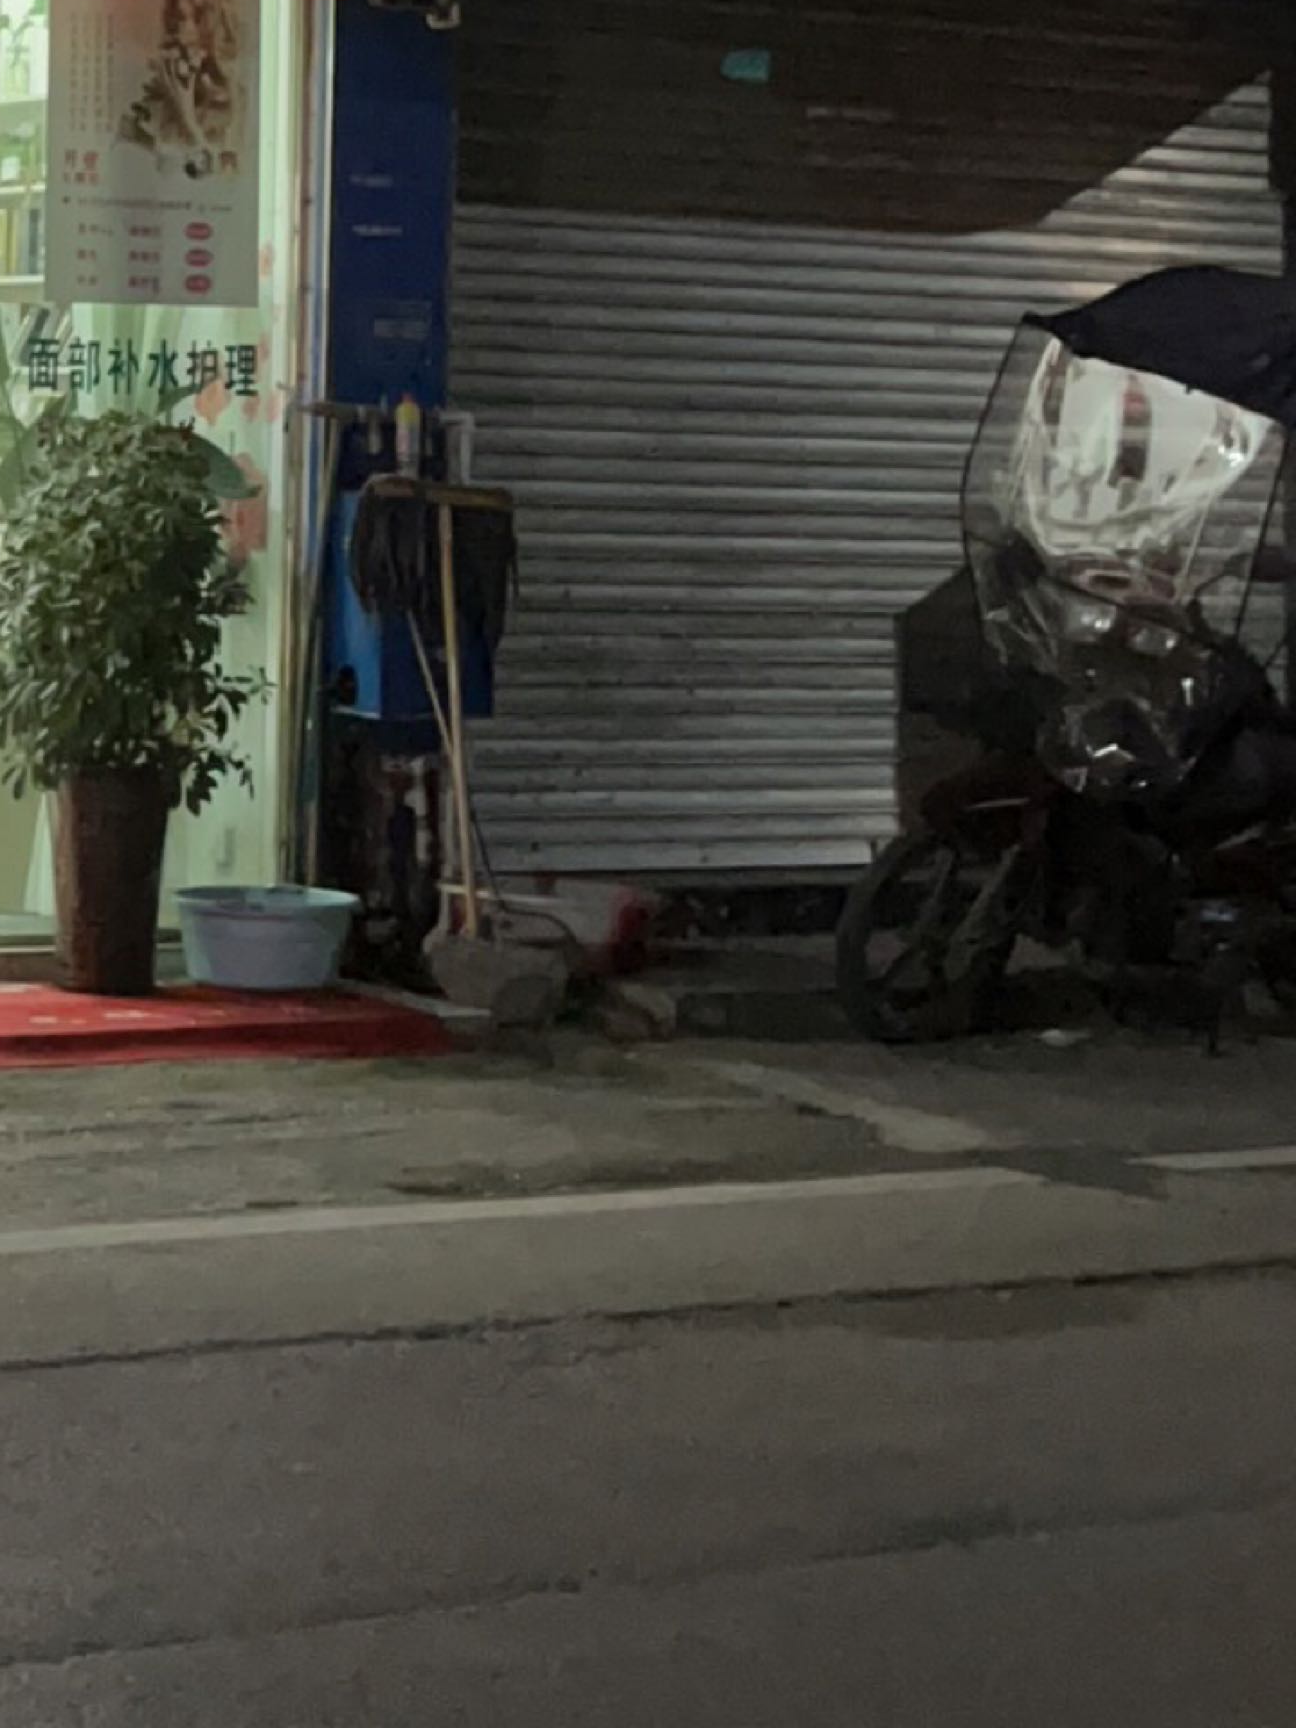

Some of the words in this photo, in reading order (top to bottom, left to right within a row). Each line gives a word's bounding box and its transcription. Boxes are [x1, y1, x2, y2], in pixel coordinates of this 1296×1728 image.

[26, 336, 259, 398] 面部补水护理
